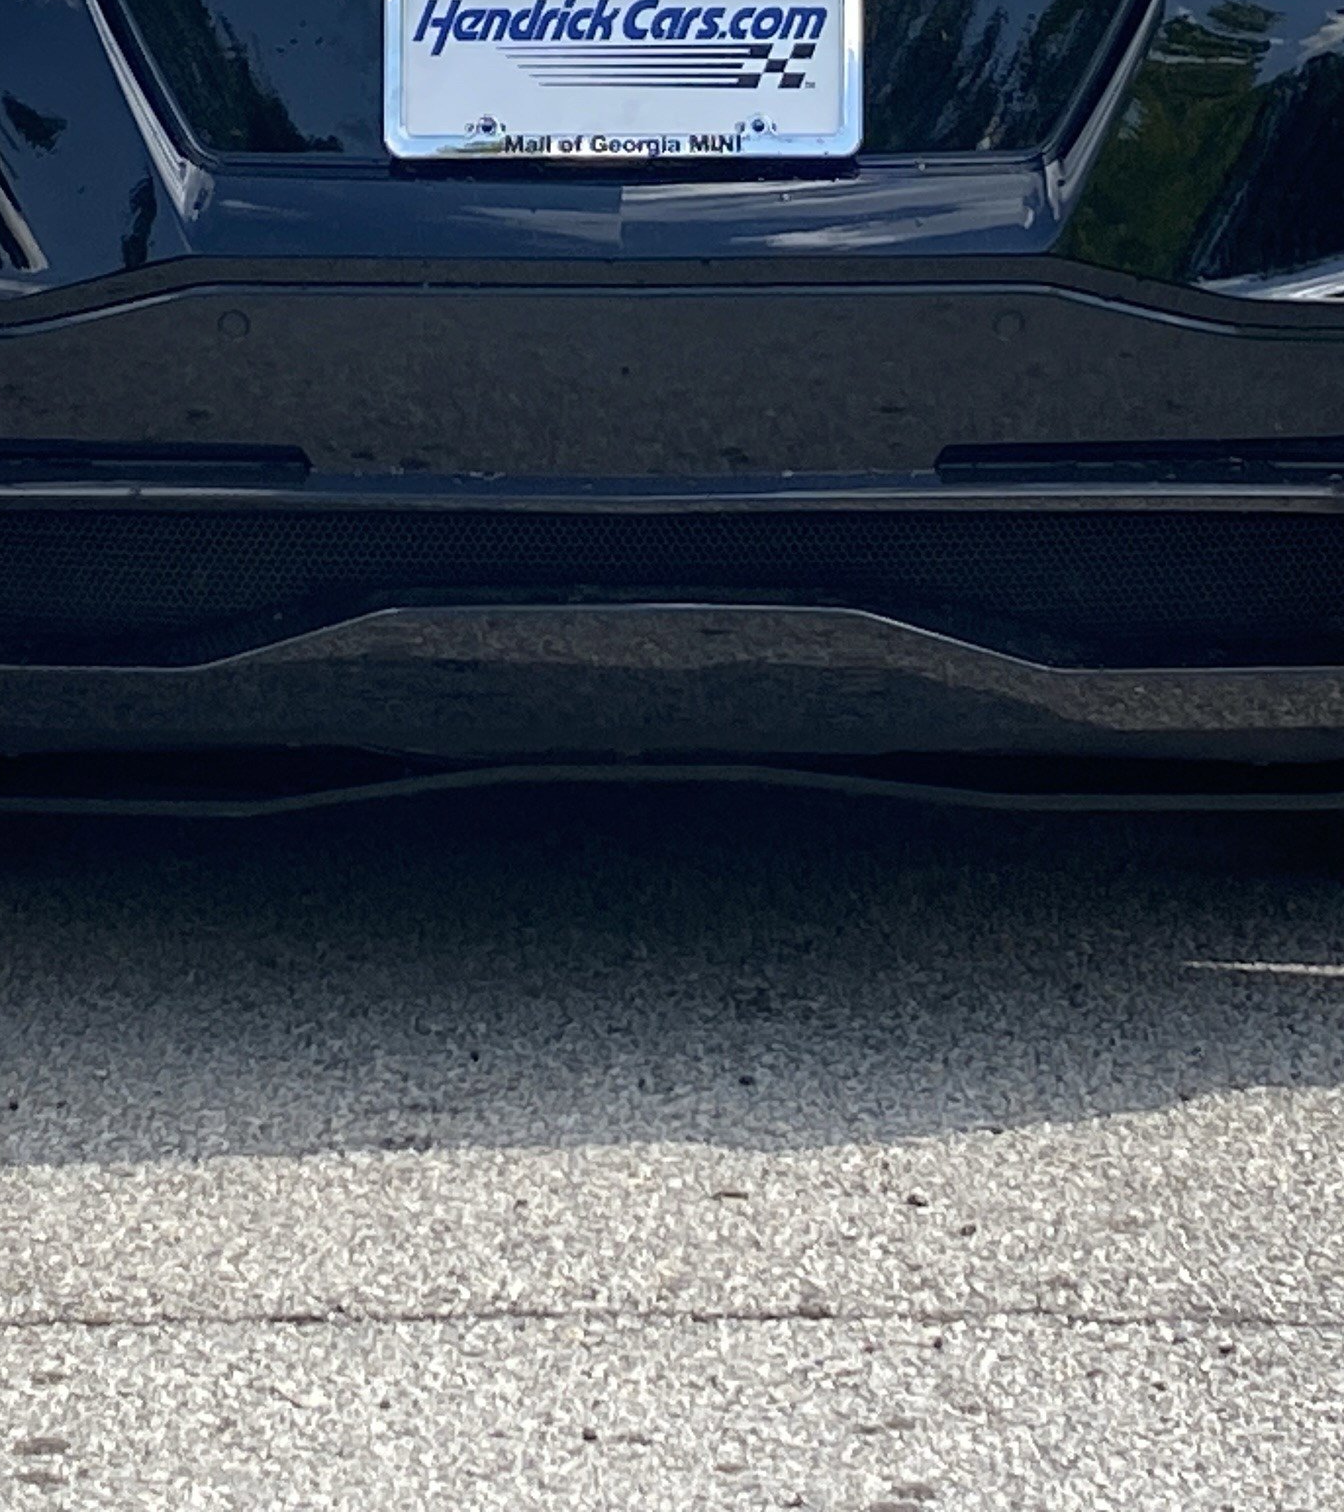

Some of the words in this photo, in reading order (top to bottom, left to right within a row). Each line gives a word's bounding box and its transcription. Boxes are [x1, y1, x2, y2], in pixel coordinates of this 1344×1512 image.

[505, 134, 551, 153] Mall
[558, 134, 583, 152] of
[590, 135, 681, 157] Georgia
